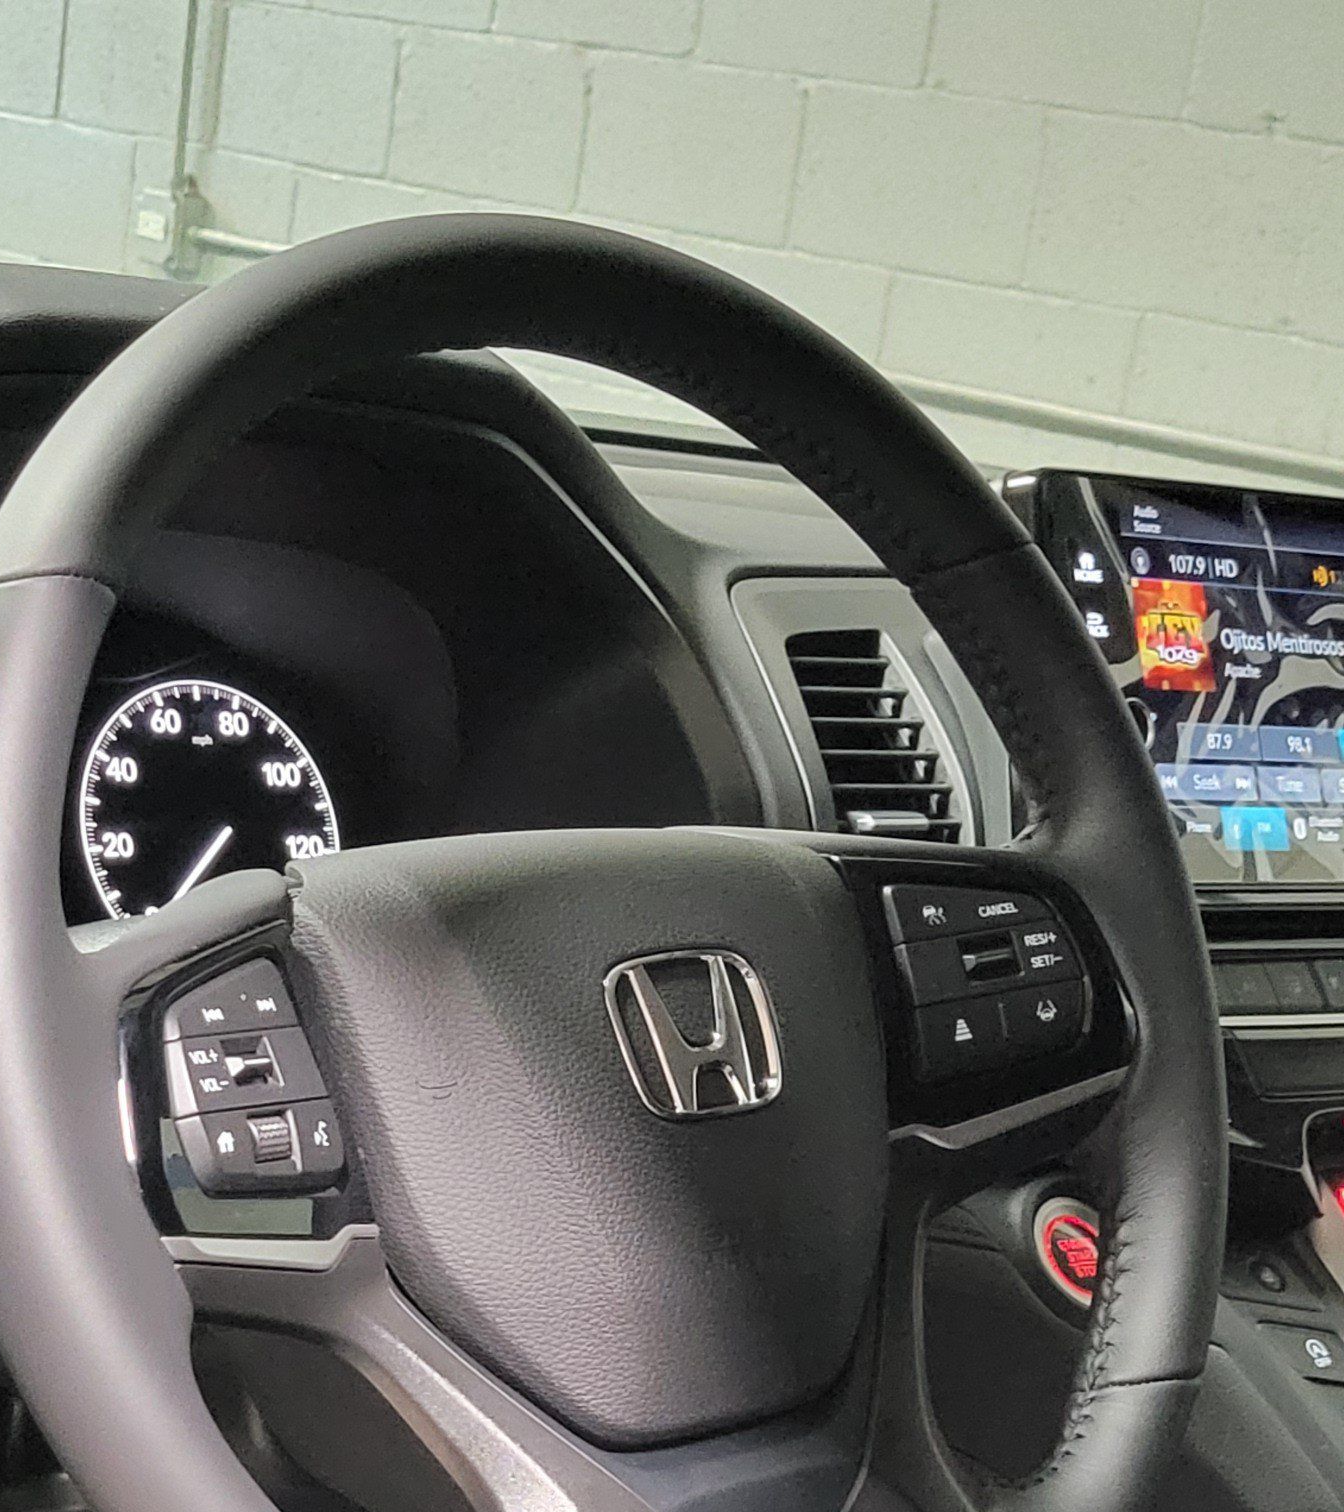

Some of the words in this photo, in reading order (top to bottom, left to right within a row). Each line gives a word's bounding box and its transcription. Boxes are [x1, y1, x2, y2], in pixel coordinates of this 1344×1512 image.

[1168, 554, 1206, 576] 107.9
[1214, 558, 1239, 579] HD
[1220, 627, 1265, 655] Ojitos
[150, 708, 182, 734] 60
[218, 711, 250, 736] 80
[106, 757, 138, 783] 40
[261, 761, 301, 787] 100
[102, 832, 135, 858] 20
[285, 834, 323, 859] 120
[978, 902, 1019, 918] CANCEL
[188, 1048, 219, 1065] VOL+
[199, 1076, 230, 1093] VOL-
